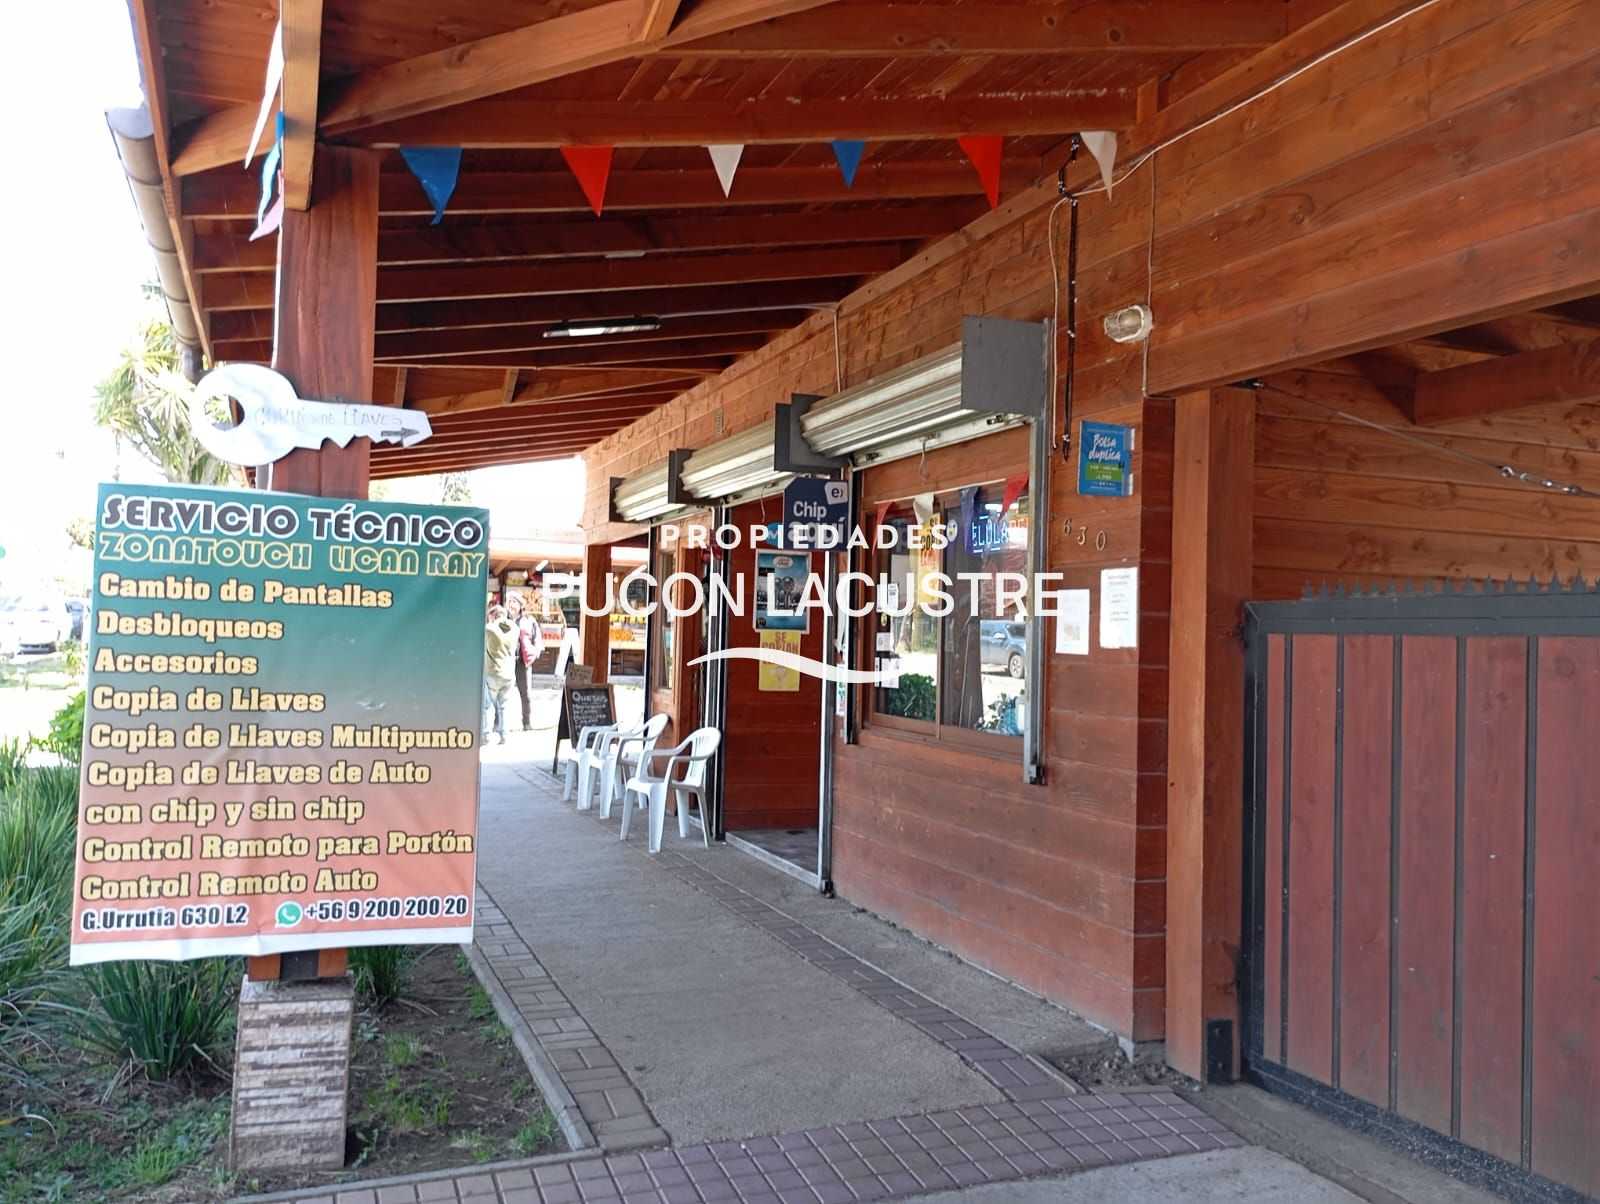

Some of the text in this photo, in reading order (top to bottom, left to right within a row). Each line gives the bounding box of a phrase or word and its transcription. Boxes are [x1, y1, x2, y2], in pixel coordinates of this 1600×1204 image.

[104, 494, 483, 548] SERVICIO TÉCNICO
[793, 500, 827, 521] Chip
[100, 532, 312, 570] ZONATOUCH
[426, 551, 486, 578] RAY
[99, 573, 394, 608] Cambio de Pantallas
[97, 610, 284, 642] Desbloqueos
[94, 648, 259, 675] Accesorios
[92, 686, 325, 715] Copia de Llaves
[90, 723, 473, 753] Copia de Llaves Multipunto
[87, 760, 431, 791] Copia de Llaves de Auto
[86, 796, 365, 827] con chip y sin chip
[83, 830, 473, 862] Control Remoto para Portón
[81, 868, 378, 900] Control Remoto Auto
[82, 896, 468, 931] G.Urrutia 630 L2 +56 9 200 200 20
